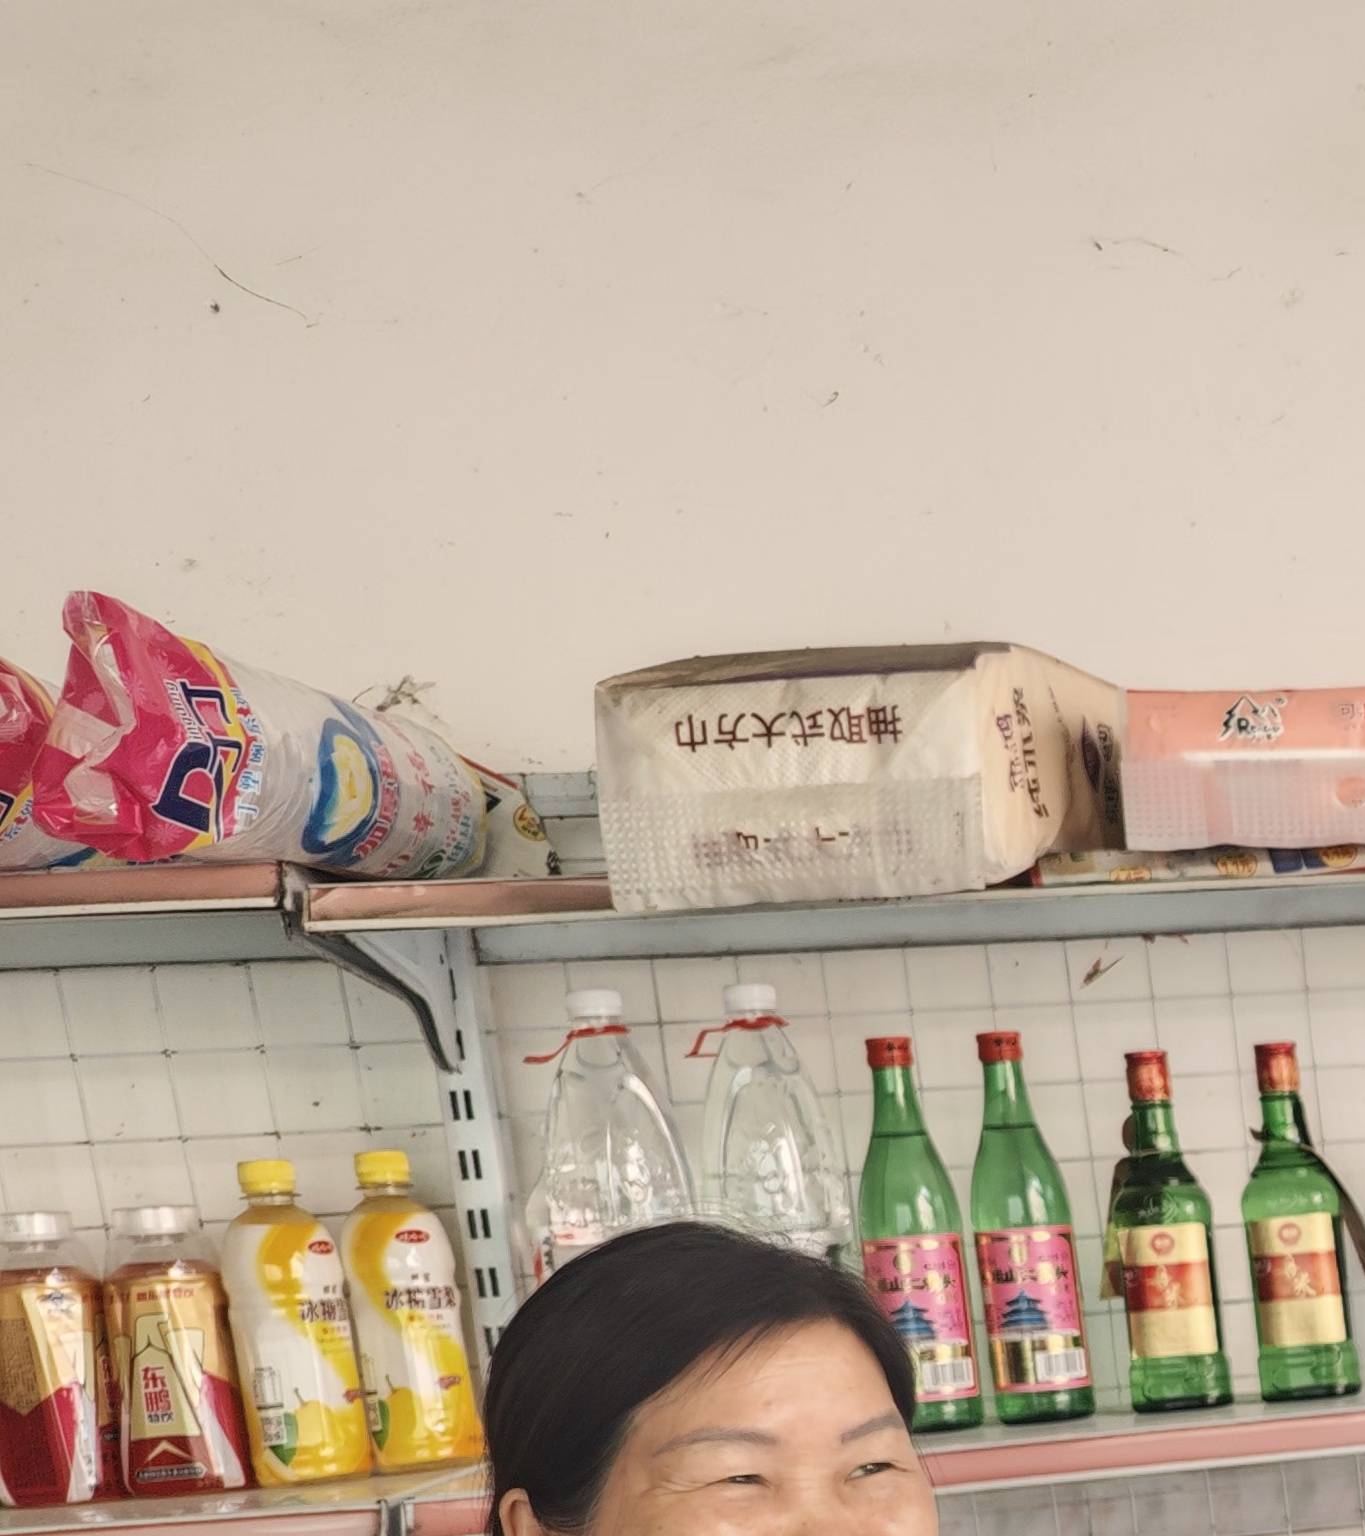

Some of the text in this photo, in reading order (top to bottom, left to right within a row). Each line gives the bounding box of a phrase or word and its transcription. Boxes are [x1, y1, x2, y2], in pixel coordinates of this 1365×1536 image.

[675, 704, 904, 751] 抽取式大方巾
